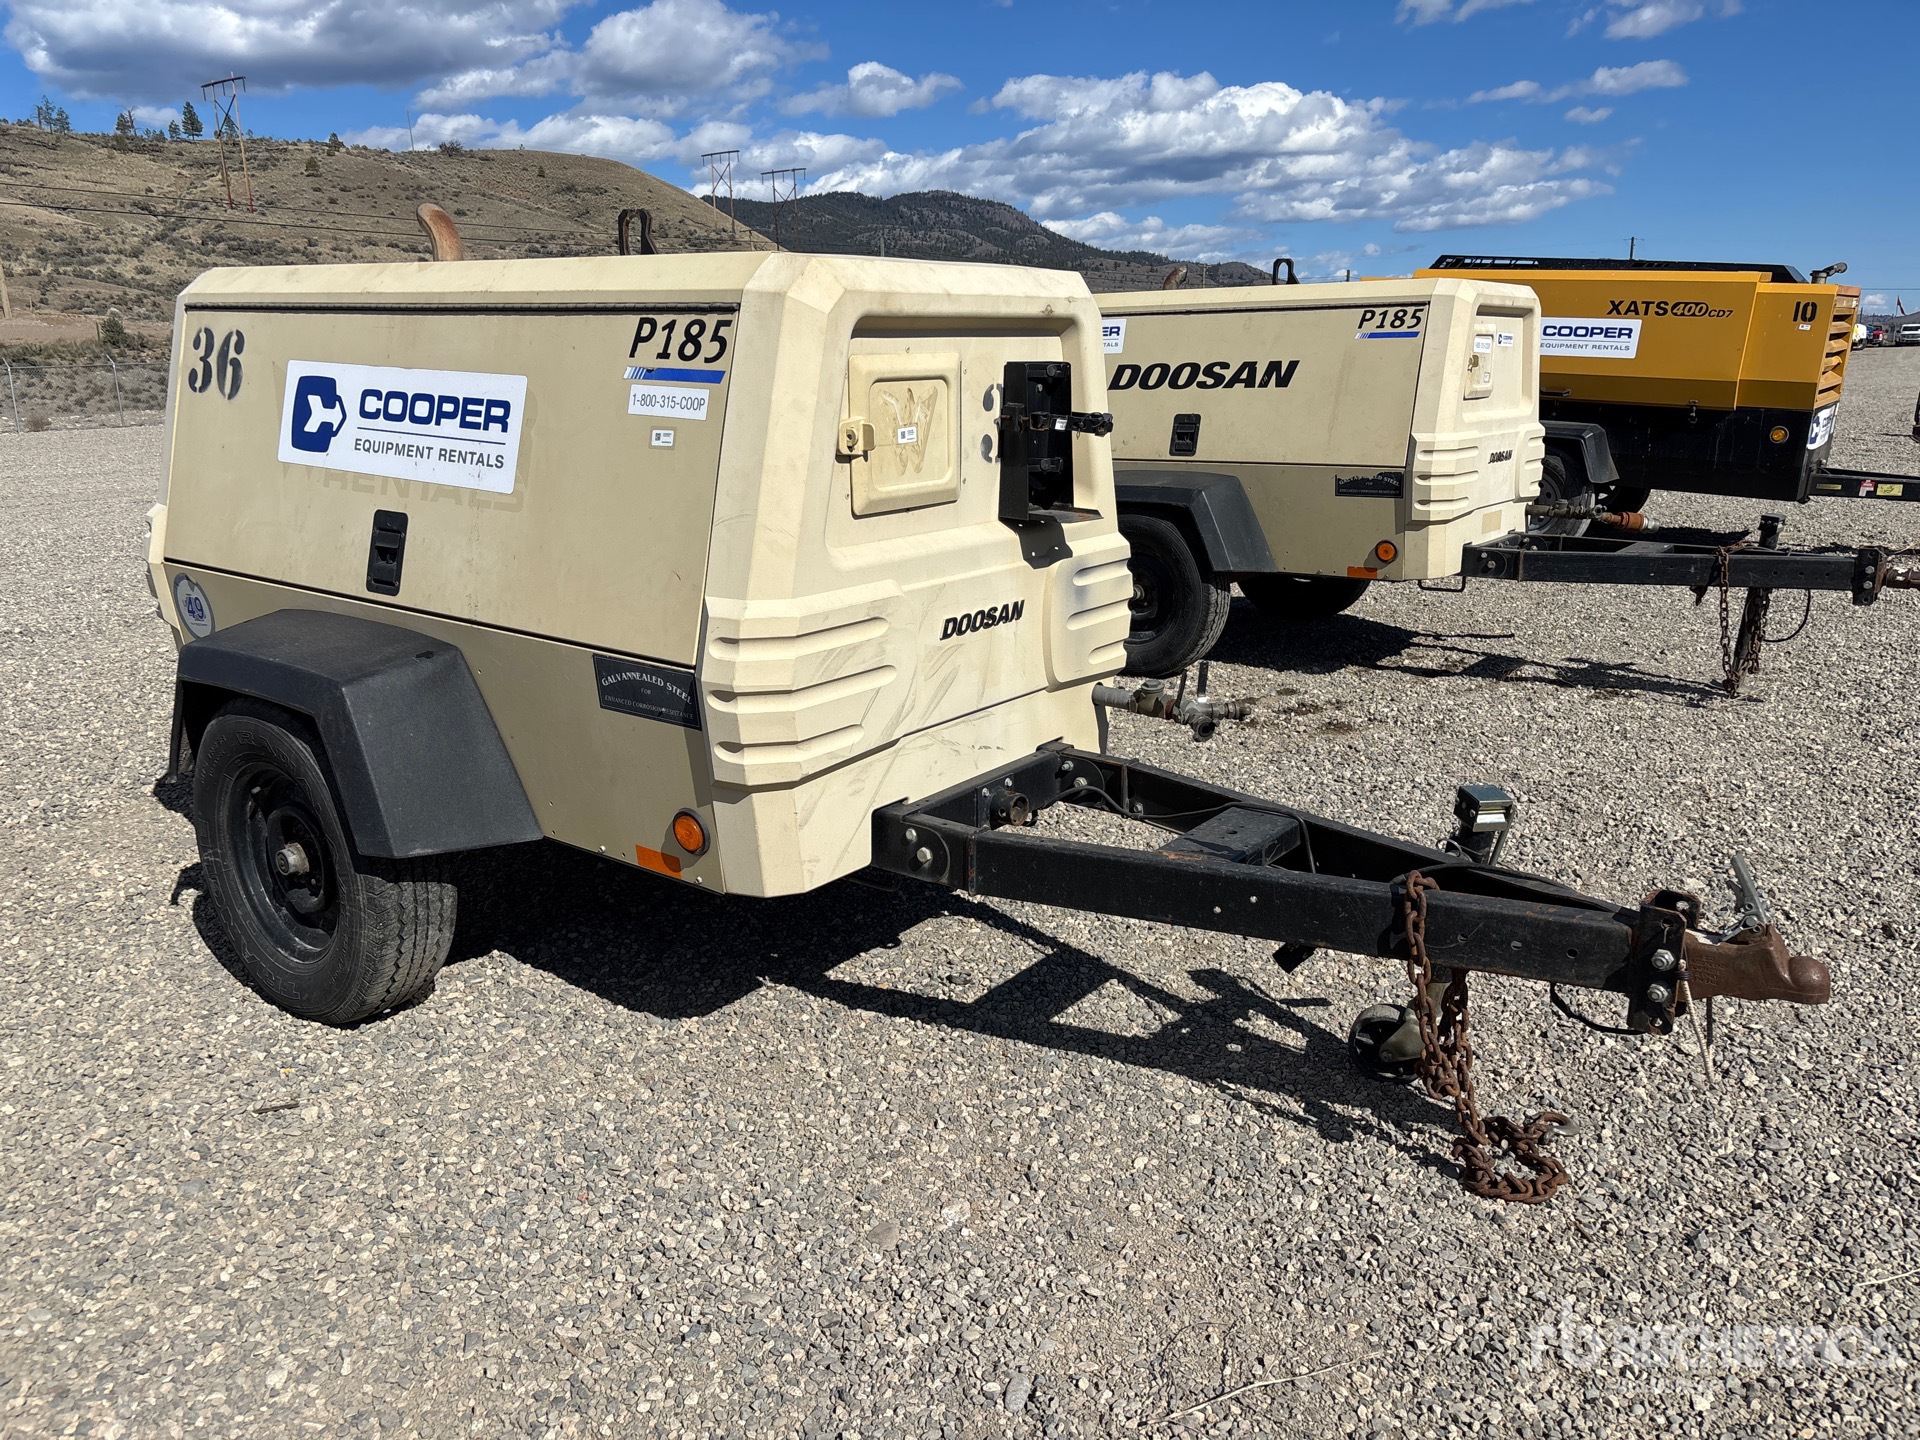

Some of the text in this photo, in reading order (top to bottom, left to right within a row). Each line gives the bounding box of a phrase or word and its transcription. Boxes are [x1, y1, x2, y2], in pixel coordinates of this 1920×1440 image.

[1357, 308, 1424, 330] P185
[1792, 301, 1818, 322] 10
[629, 317, 733, 364] P185
[1539, 342, 1589, 350] EQUIPMENT
[1542, 324, 1633, 339] COOPER
[188, 327, 246, 400] 36
[1108, 359, 1300, 391] DOOSAN
[359, 388, 512, 434] COOPER
[632, 393, 706, 411] 1-800-315-COOP
[354, 438, 505, 469] EQUIPMENT RENTALS
[187, 596, 204, 619] 49
[939, 599, 1025, 641] DOOSAN
[601, 671, 692, 705] GALVANNEALED STEEL
